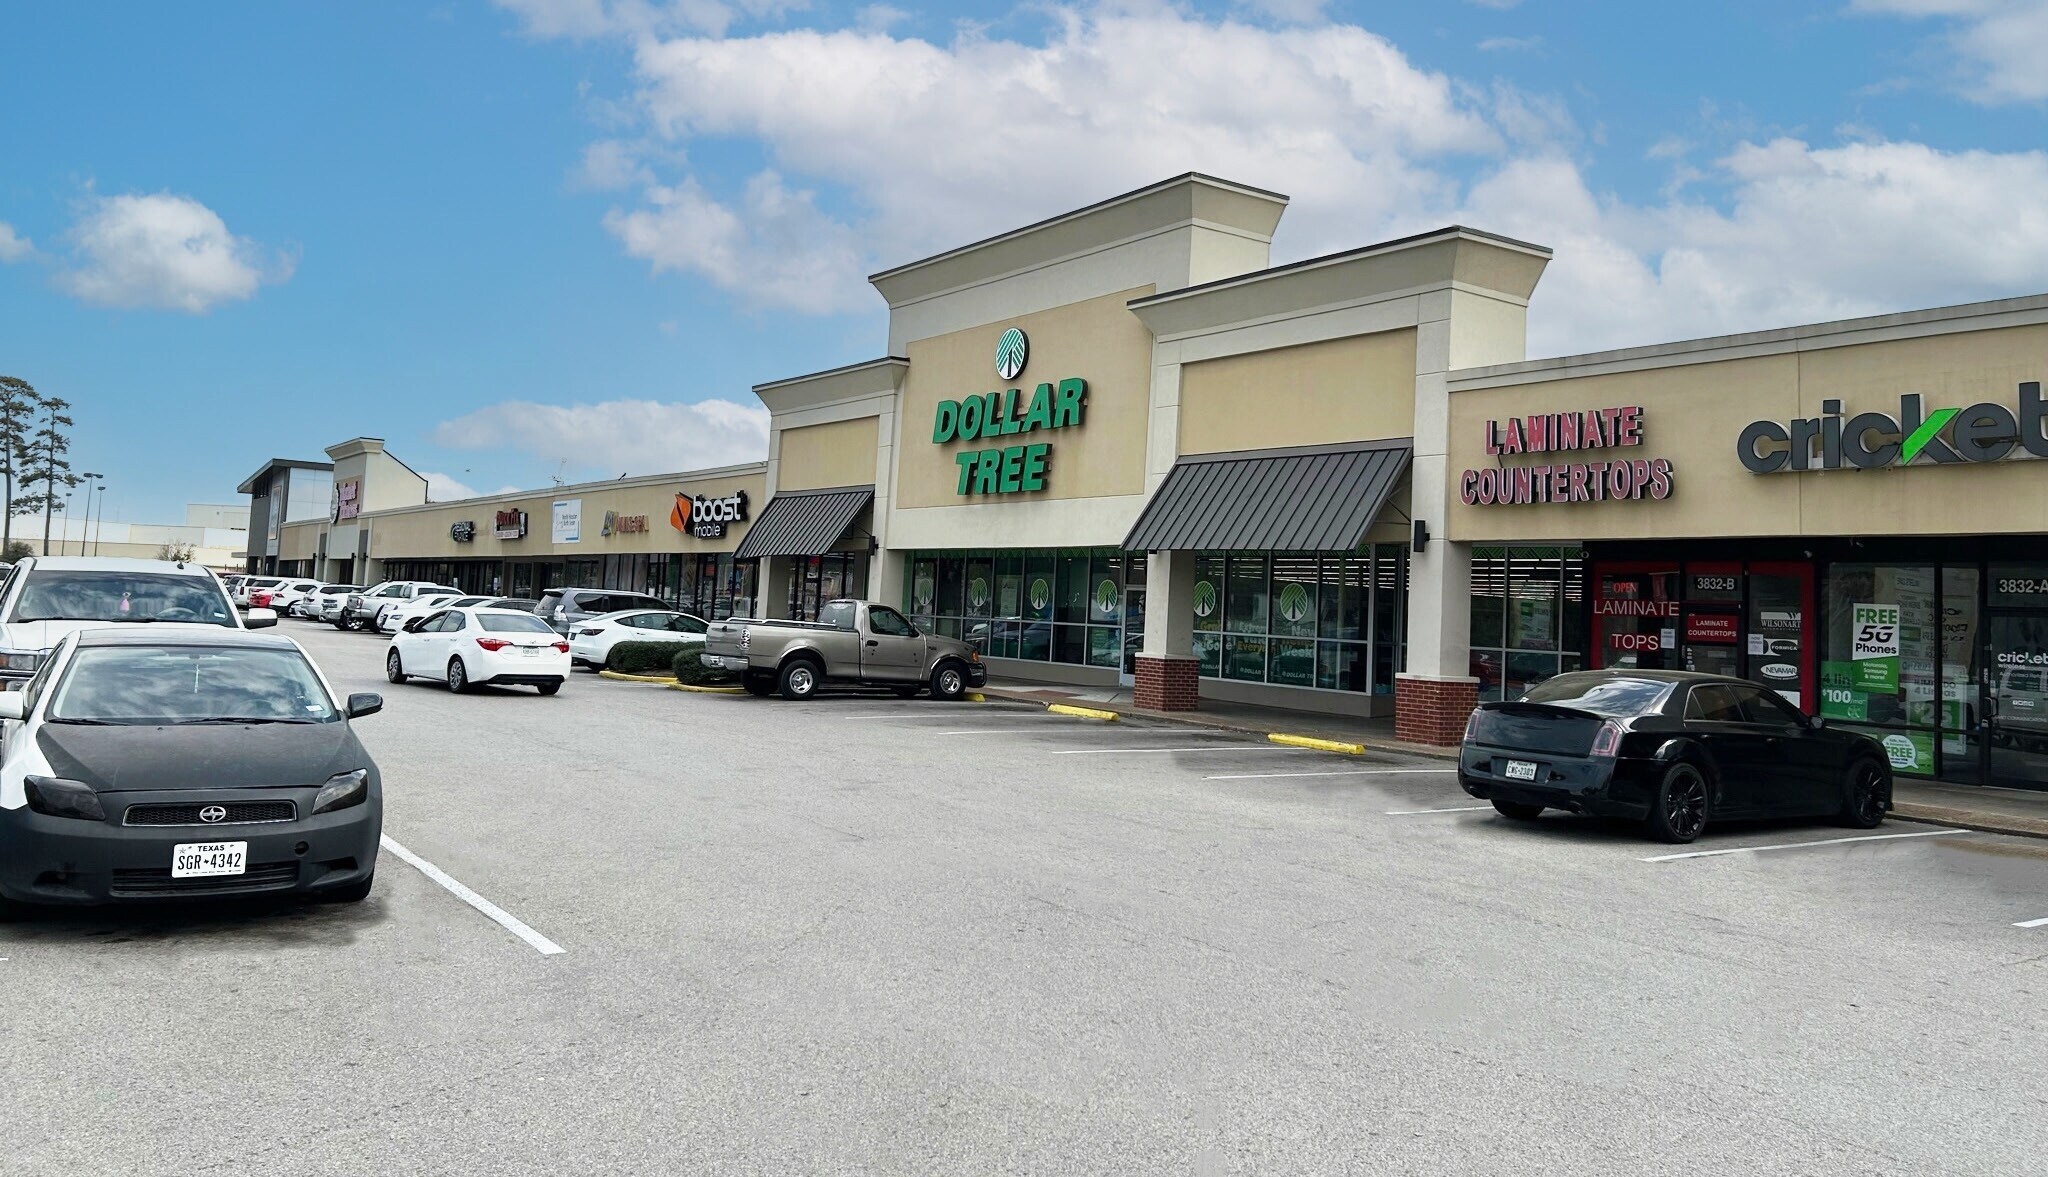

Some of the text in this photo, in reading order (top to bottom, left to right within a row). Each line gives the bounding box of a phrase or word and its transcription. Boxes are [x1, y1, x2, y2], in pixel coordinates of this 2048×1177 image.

[932, 377, 1088, 444] DOLLAR
[1485, 406, 1643, 455] LAMINATE
[1737, 381, 2048, 474] cricket
[955, 443, 1052, 495] TREE
[1460, 458, 1673, 505] COUNTERTOPS
[692, 490, 744, 522] boost
[694, 524, 721, 538] mobile
[1613, 582, 1637, 593] OPEN
[1697, 577, 1735, 590] 3832-B
[1594, 600, 1680, 617] LAMINATE
[1856, 608, 1897, 624] FREE
[1695, 619, 1729, 628] LAMINATE
[1761, 620, 1801, 628] WILSONART
[1687, 629, 1737, 637] COUNTERTOPS
[1858, 625, 1894, 643] 5G
[1612, 633, 1659, 650] TOPS
[1856, 643, 1897, 654] Phones
[1765, 666, 1797, 675] NEVAMAR
[197, 844, 225, 852] TEXAS
[178, 852, 242, 870] SGR 4342
